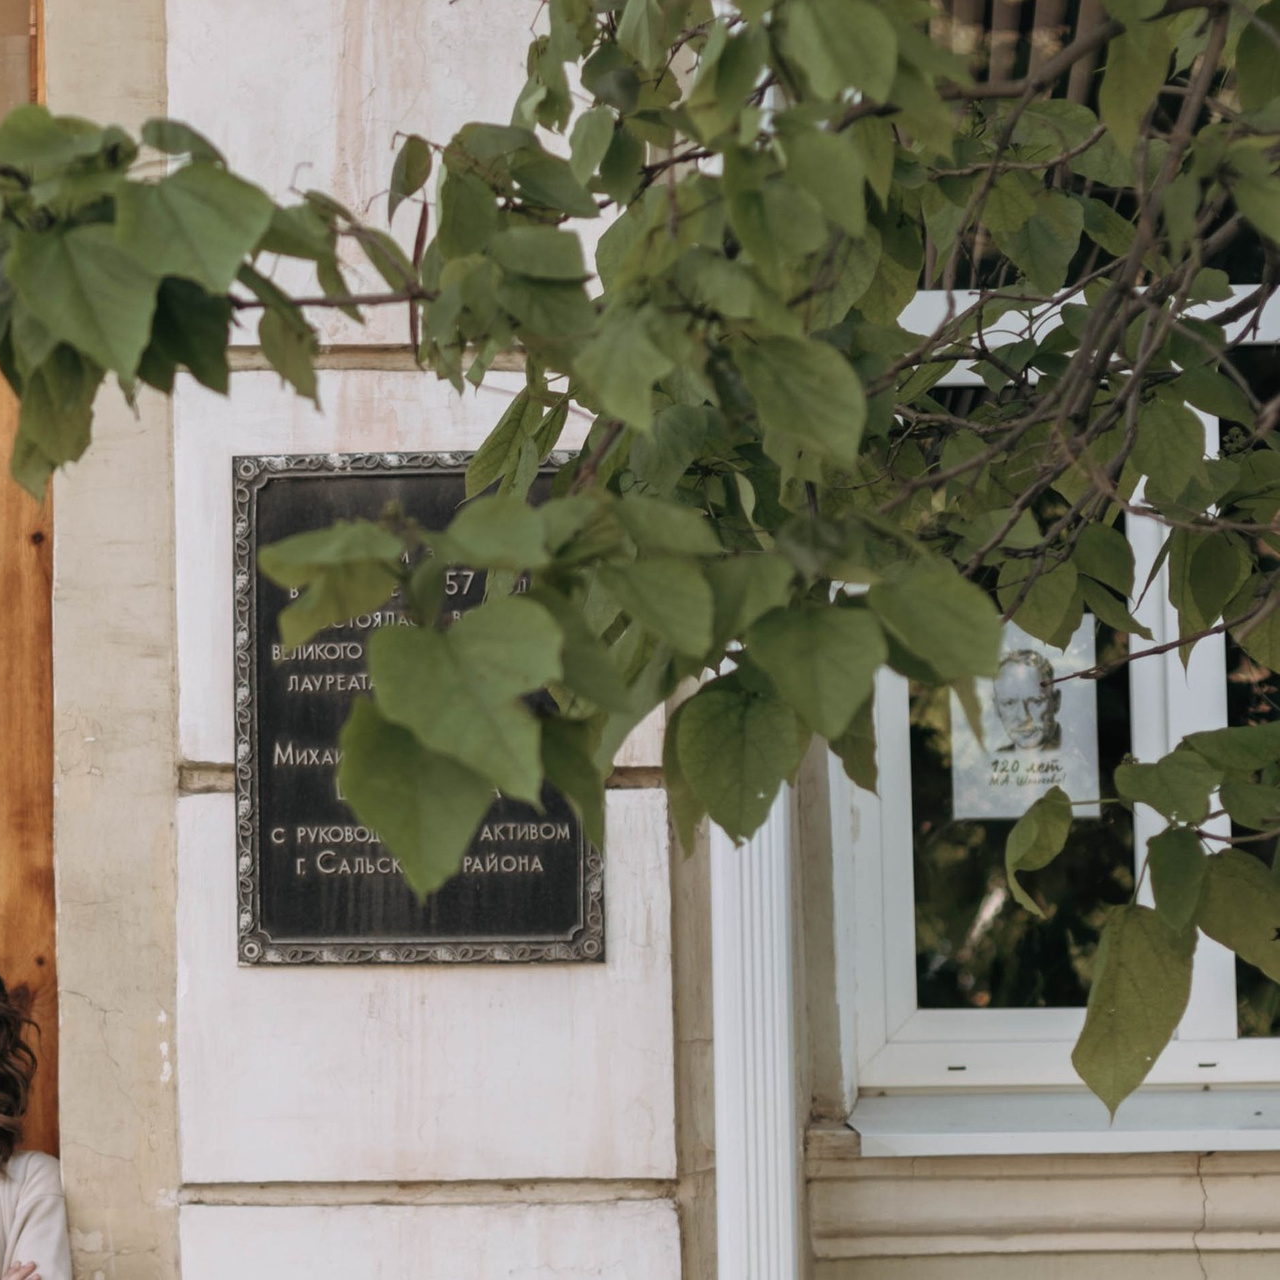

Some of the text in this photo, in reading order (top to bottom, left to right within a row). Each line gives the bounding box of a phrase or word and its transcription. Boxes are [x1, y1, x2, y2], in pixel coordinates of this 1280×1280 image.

[991, 759, 1020, 773] 120
[480, 822, 571, 841] АКТИВОМ
[463, 853, 544, 873] РАЙОНА
